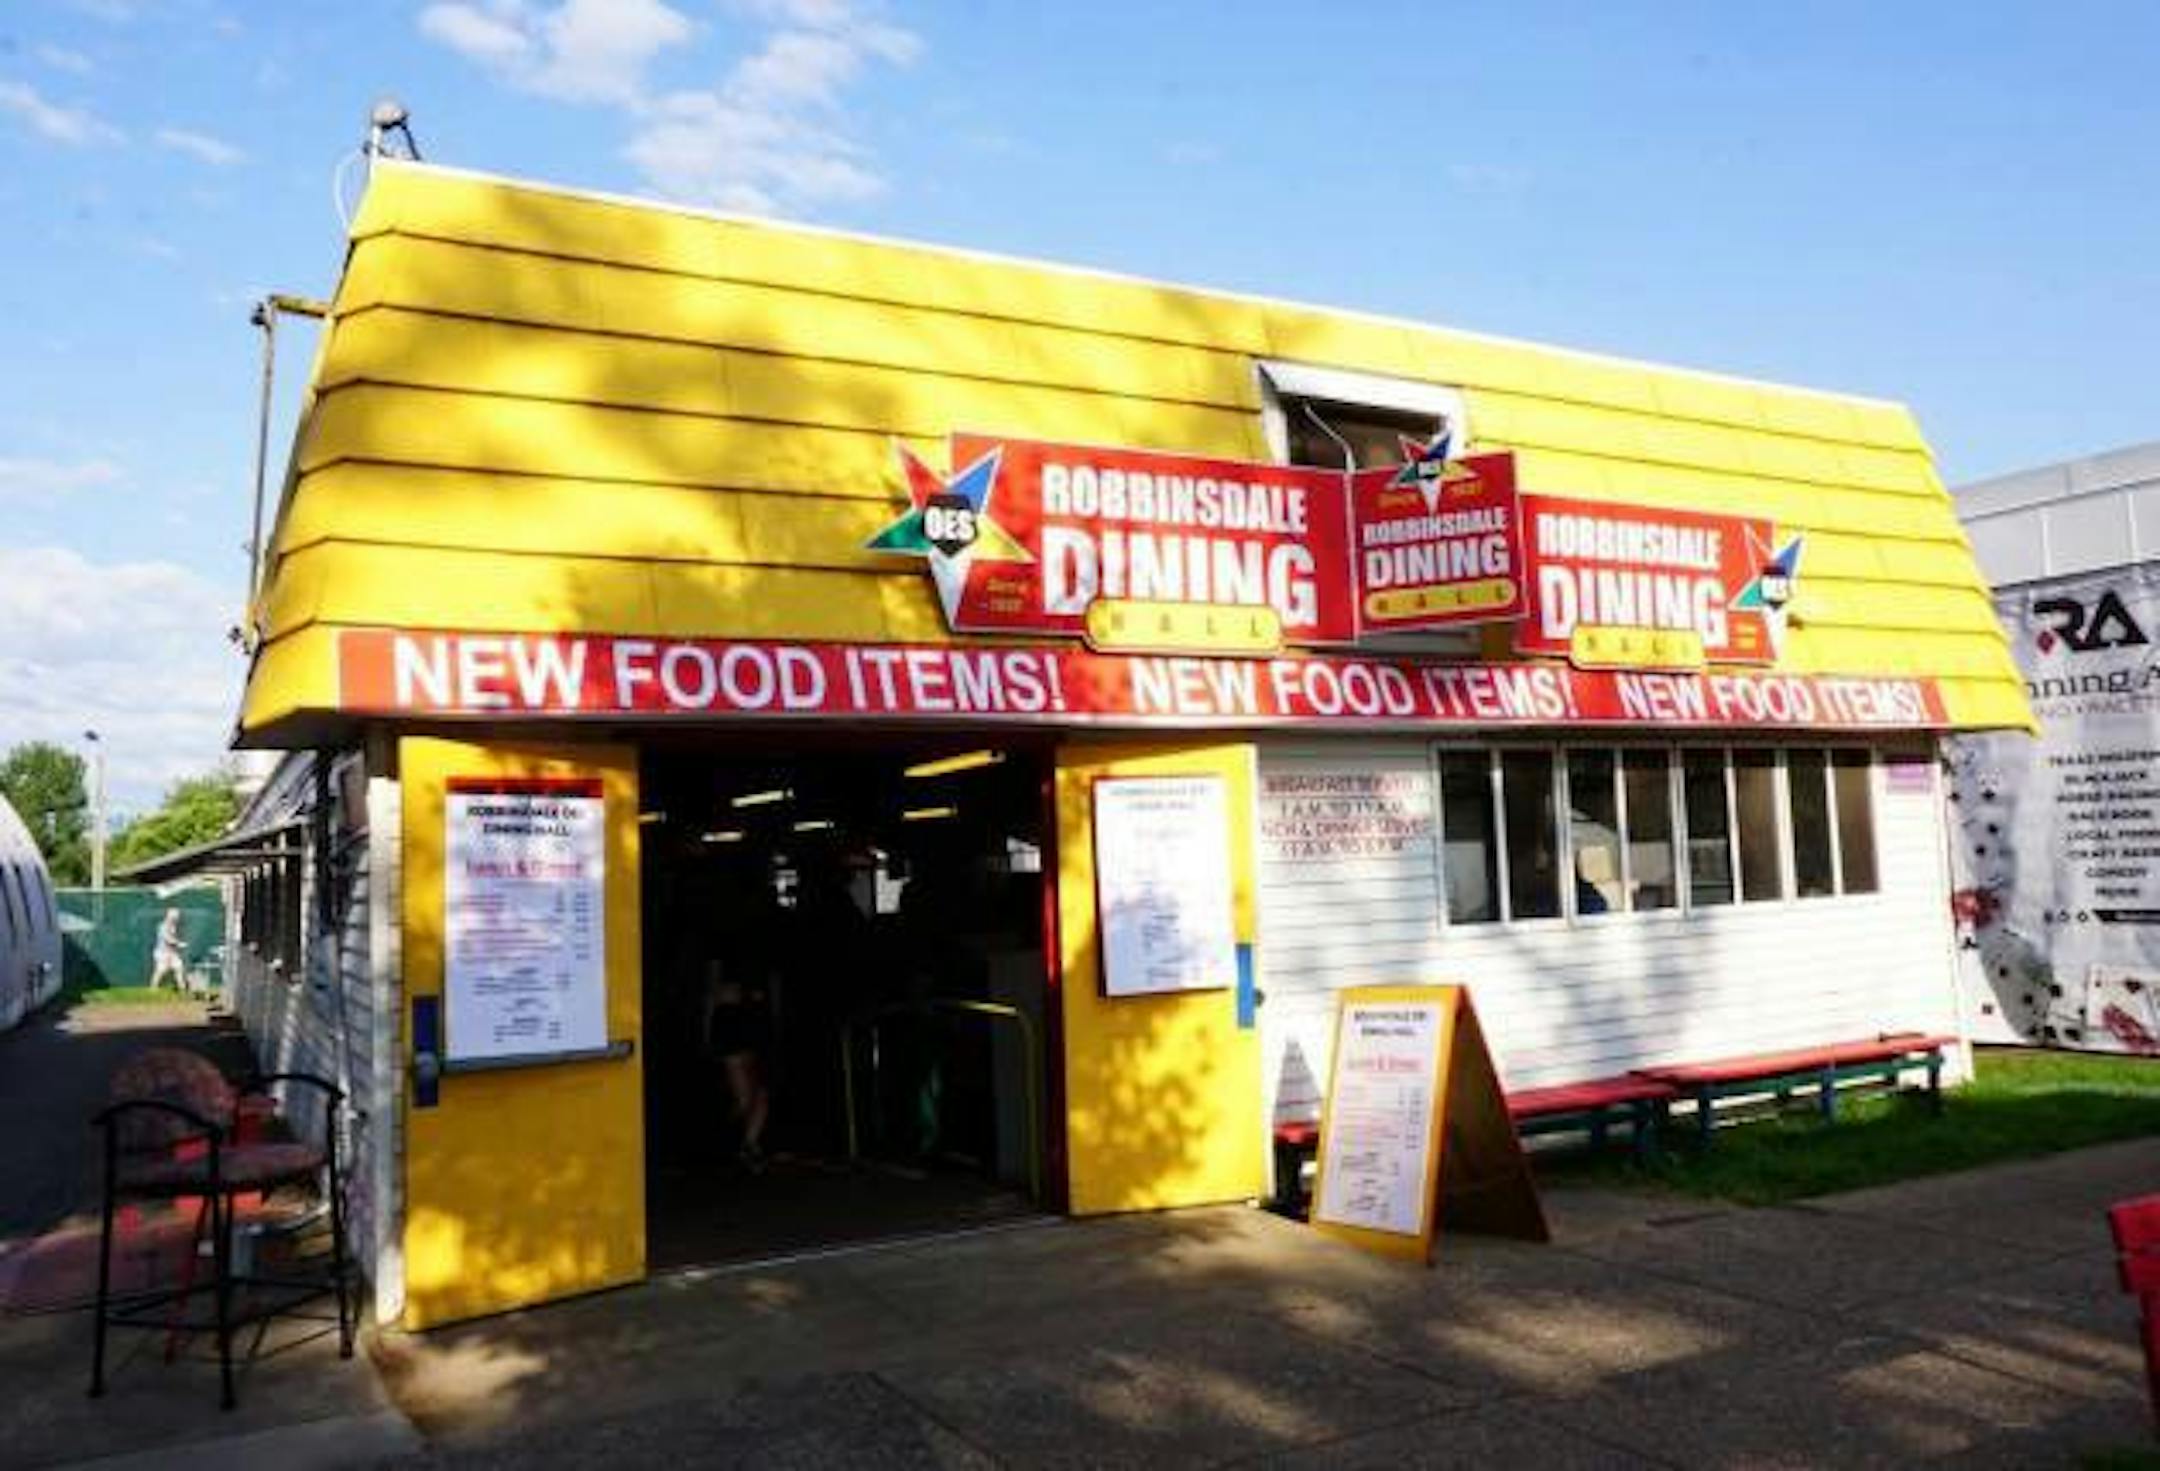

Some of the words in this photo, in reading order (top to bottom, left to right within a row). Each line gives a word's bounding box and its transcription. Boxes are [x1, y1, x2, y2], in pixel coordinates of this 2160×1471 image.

[924, 506, 975, 541] OES
[1042, 463, 1307, 533] ROBBINSDALE
[1363, 506, 1508, 547] ROBBINSDALE
[1366, 534, 1510, 589] DINING
[1537, 513, 1721, 568] ROBBINSDALE
[1043, 526, 1317, 627] DINING
[1110, 610, 1261, 639] HALL
[1539, 564, 1728, 649] DINING
[2033, 590, 2150, 652] RA
[394, 636, 586, 710] NEW
[611, 642, 825, 711] FOOD
[847, 651, 1066, 713] ITEMS!
[1130, 660, 1258, 714] NEW
[1269, 663, 1414, 716] FOOD
[1420, 668, 1577, 719] ITEMS!
[1617, 673, 1709, 719] NEW
[1711, 677, 1812, 722] FOOD
[1817, 681, 1926, 724] ITEMS!
